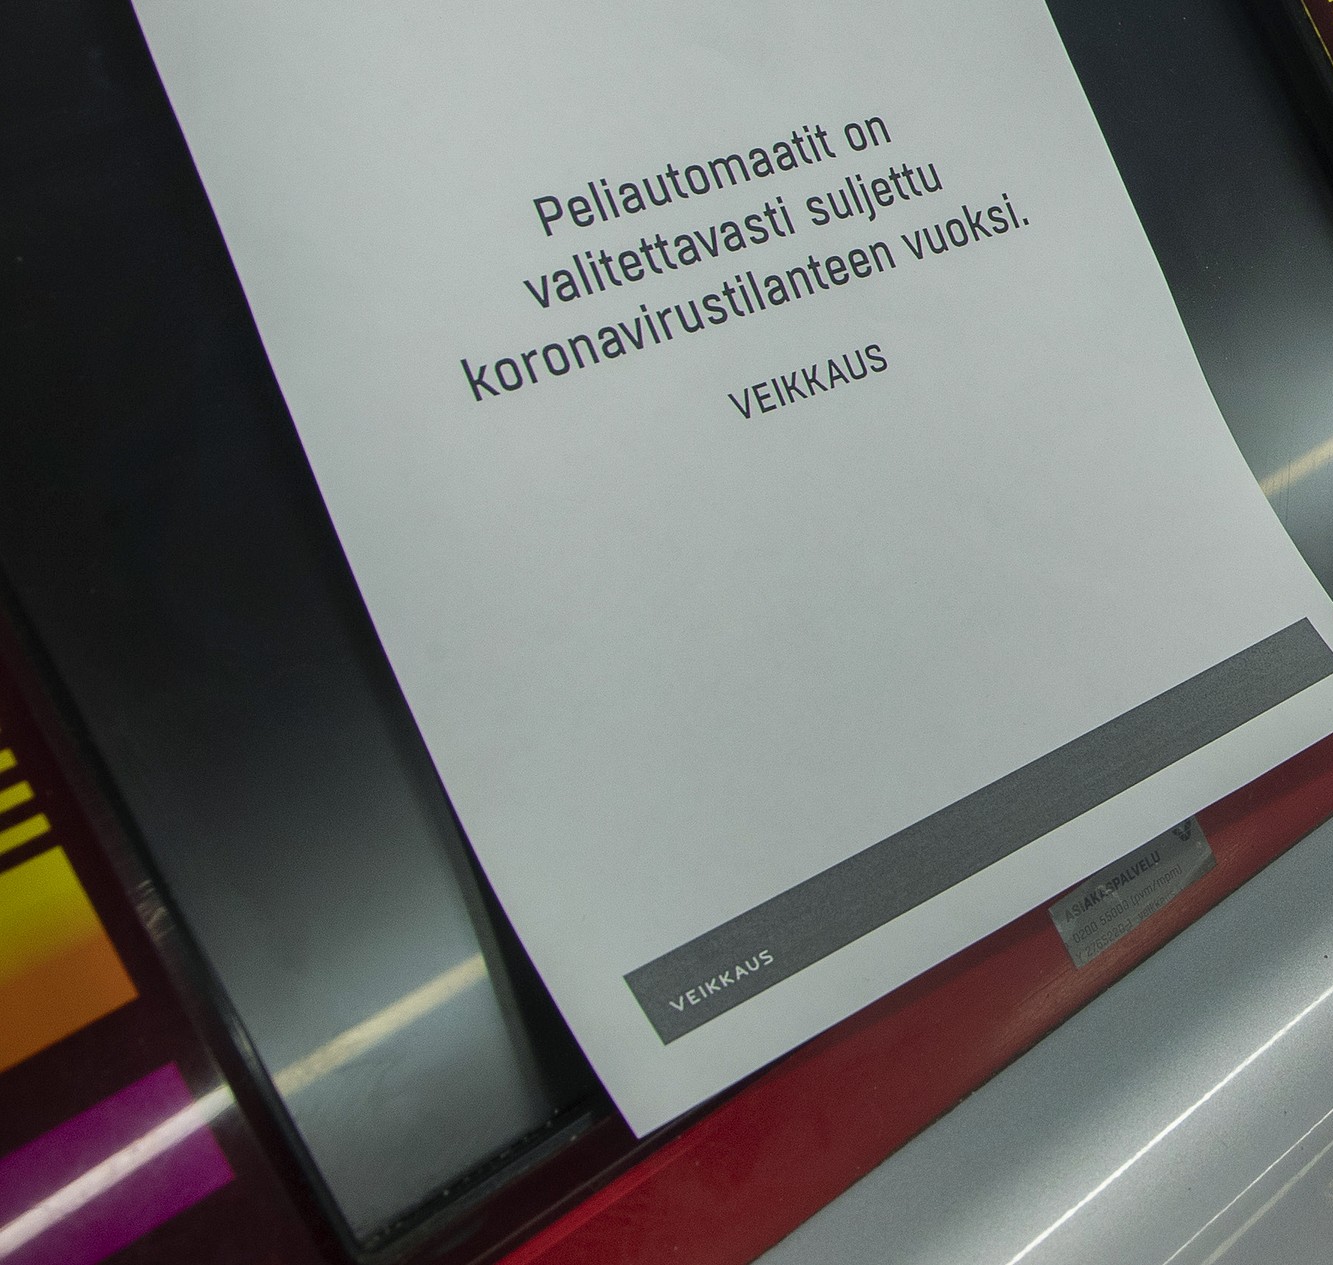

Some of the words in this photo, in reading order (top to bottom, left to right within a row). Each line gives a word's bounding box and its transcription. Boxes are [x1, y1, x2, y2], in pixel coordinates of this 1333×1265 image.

[533, 123, 836, 237] Peliautomaatit
[843, 115, 892, 151] on
[523, 196, 795, 310] valitettavasti
[806, 162, 943, 222] suljettu
[459, 239, 897, 402] koronavirustilanteen
[901, 192, 1031, 261] vuoksi.
[728, 344, 889, 420] VEIKKAUS
[1065, 850, 1162, 923] ASIAKASPALVELU
[1072, 921, 1098, 944] 0200
[1099, 900, 1129, 927] 55000
[669, 949, 775, 1012] VEIKKAUS
